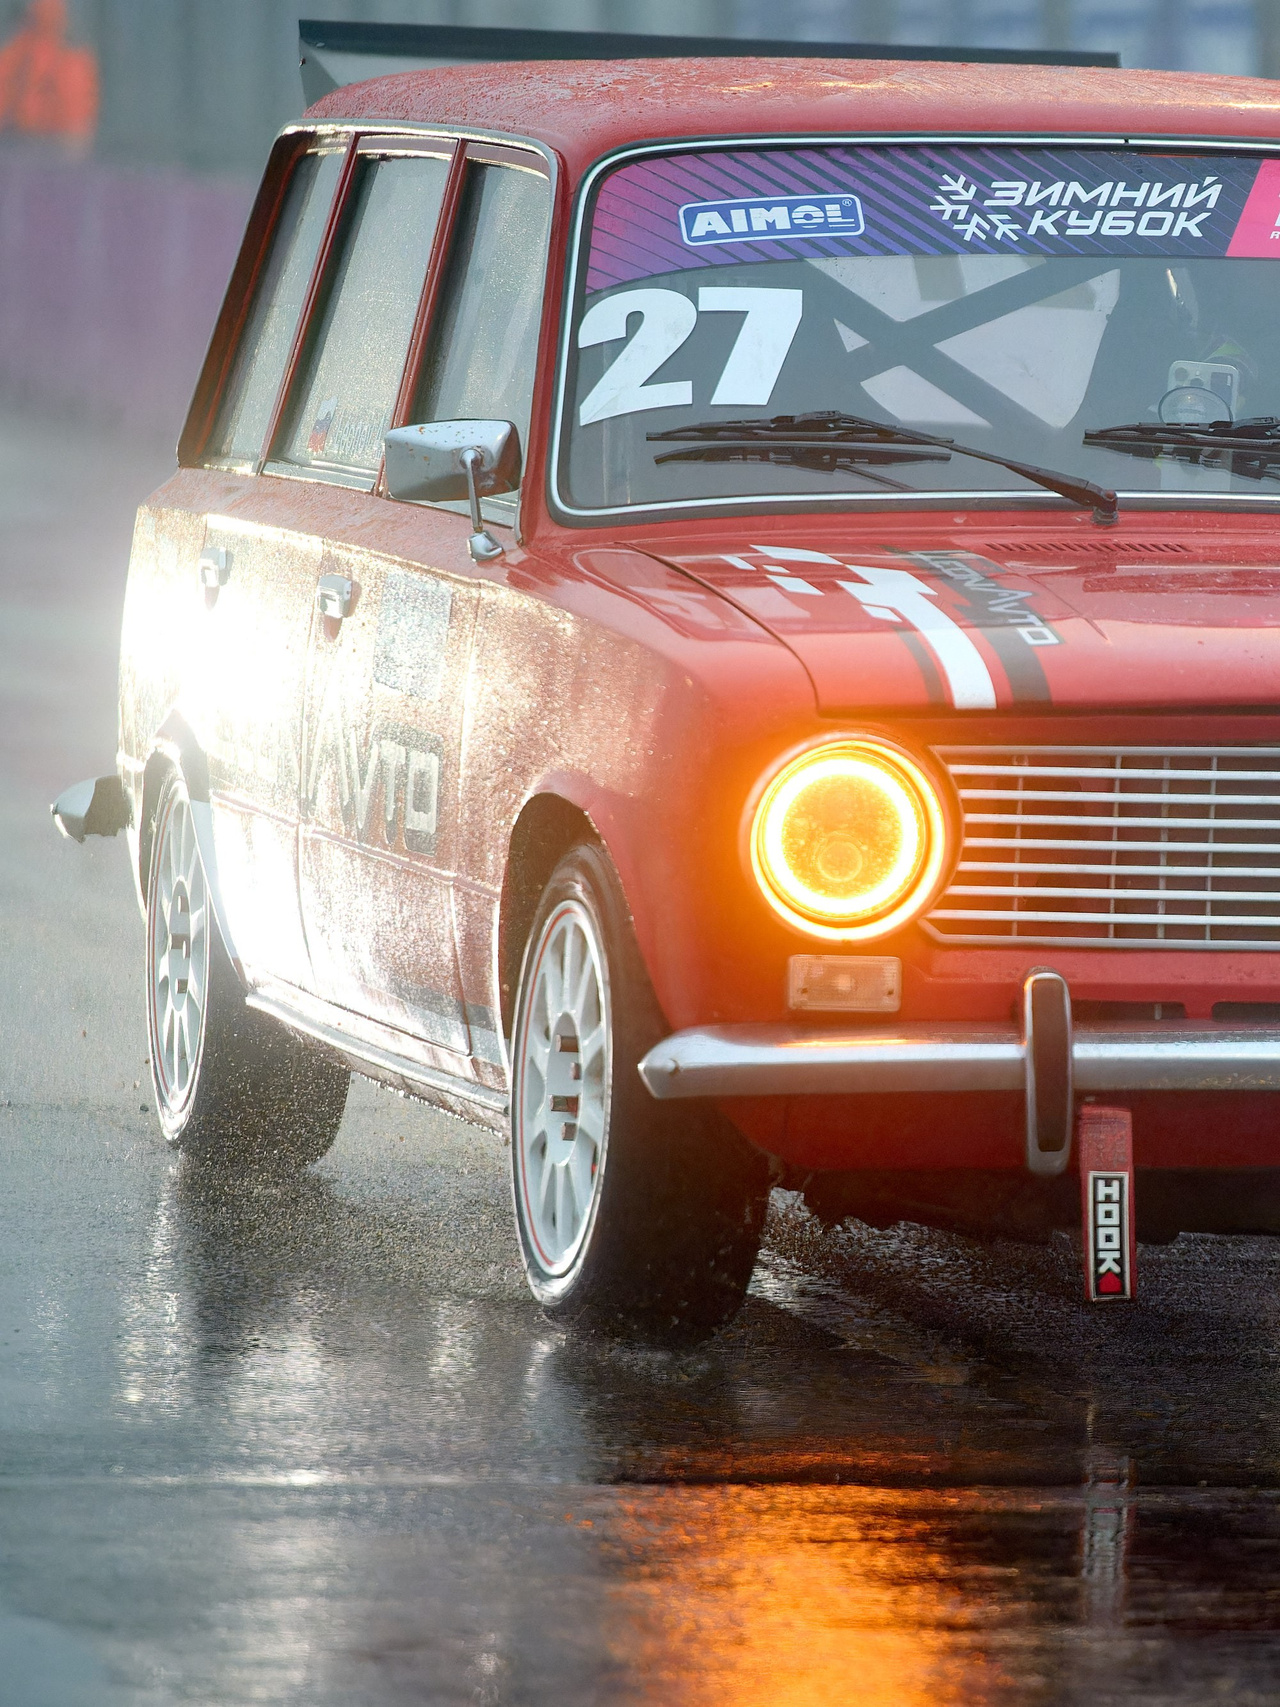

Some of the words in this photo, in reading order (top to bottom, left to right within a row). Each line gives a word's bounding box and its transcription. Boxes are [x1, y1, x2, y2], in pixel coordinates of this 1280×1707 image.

[983, 176, 1223, 208] ЗИМНИЙ
[1027, 210, 1212, 238] КУБОК
[578, 286, 803, 427] 27
[1097, 1178, 1121, 1275] HOOK
